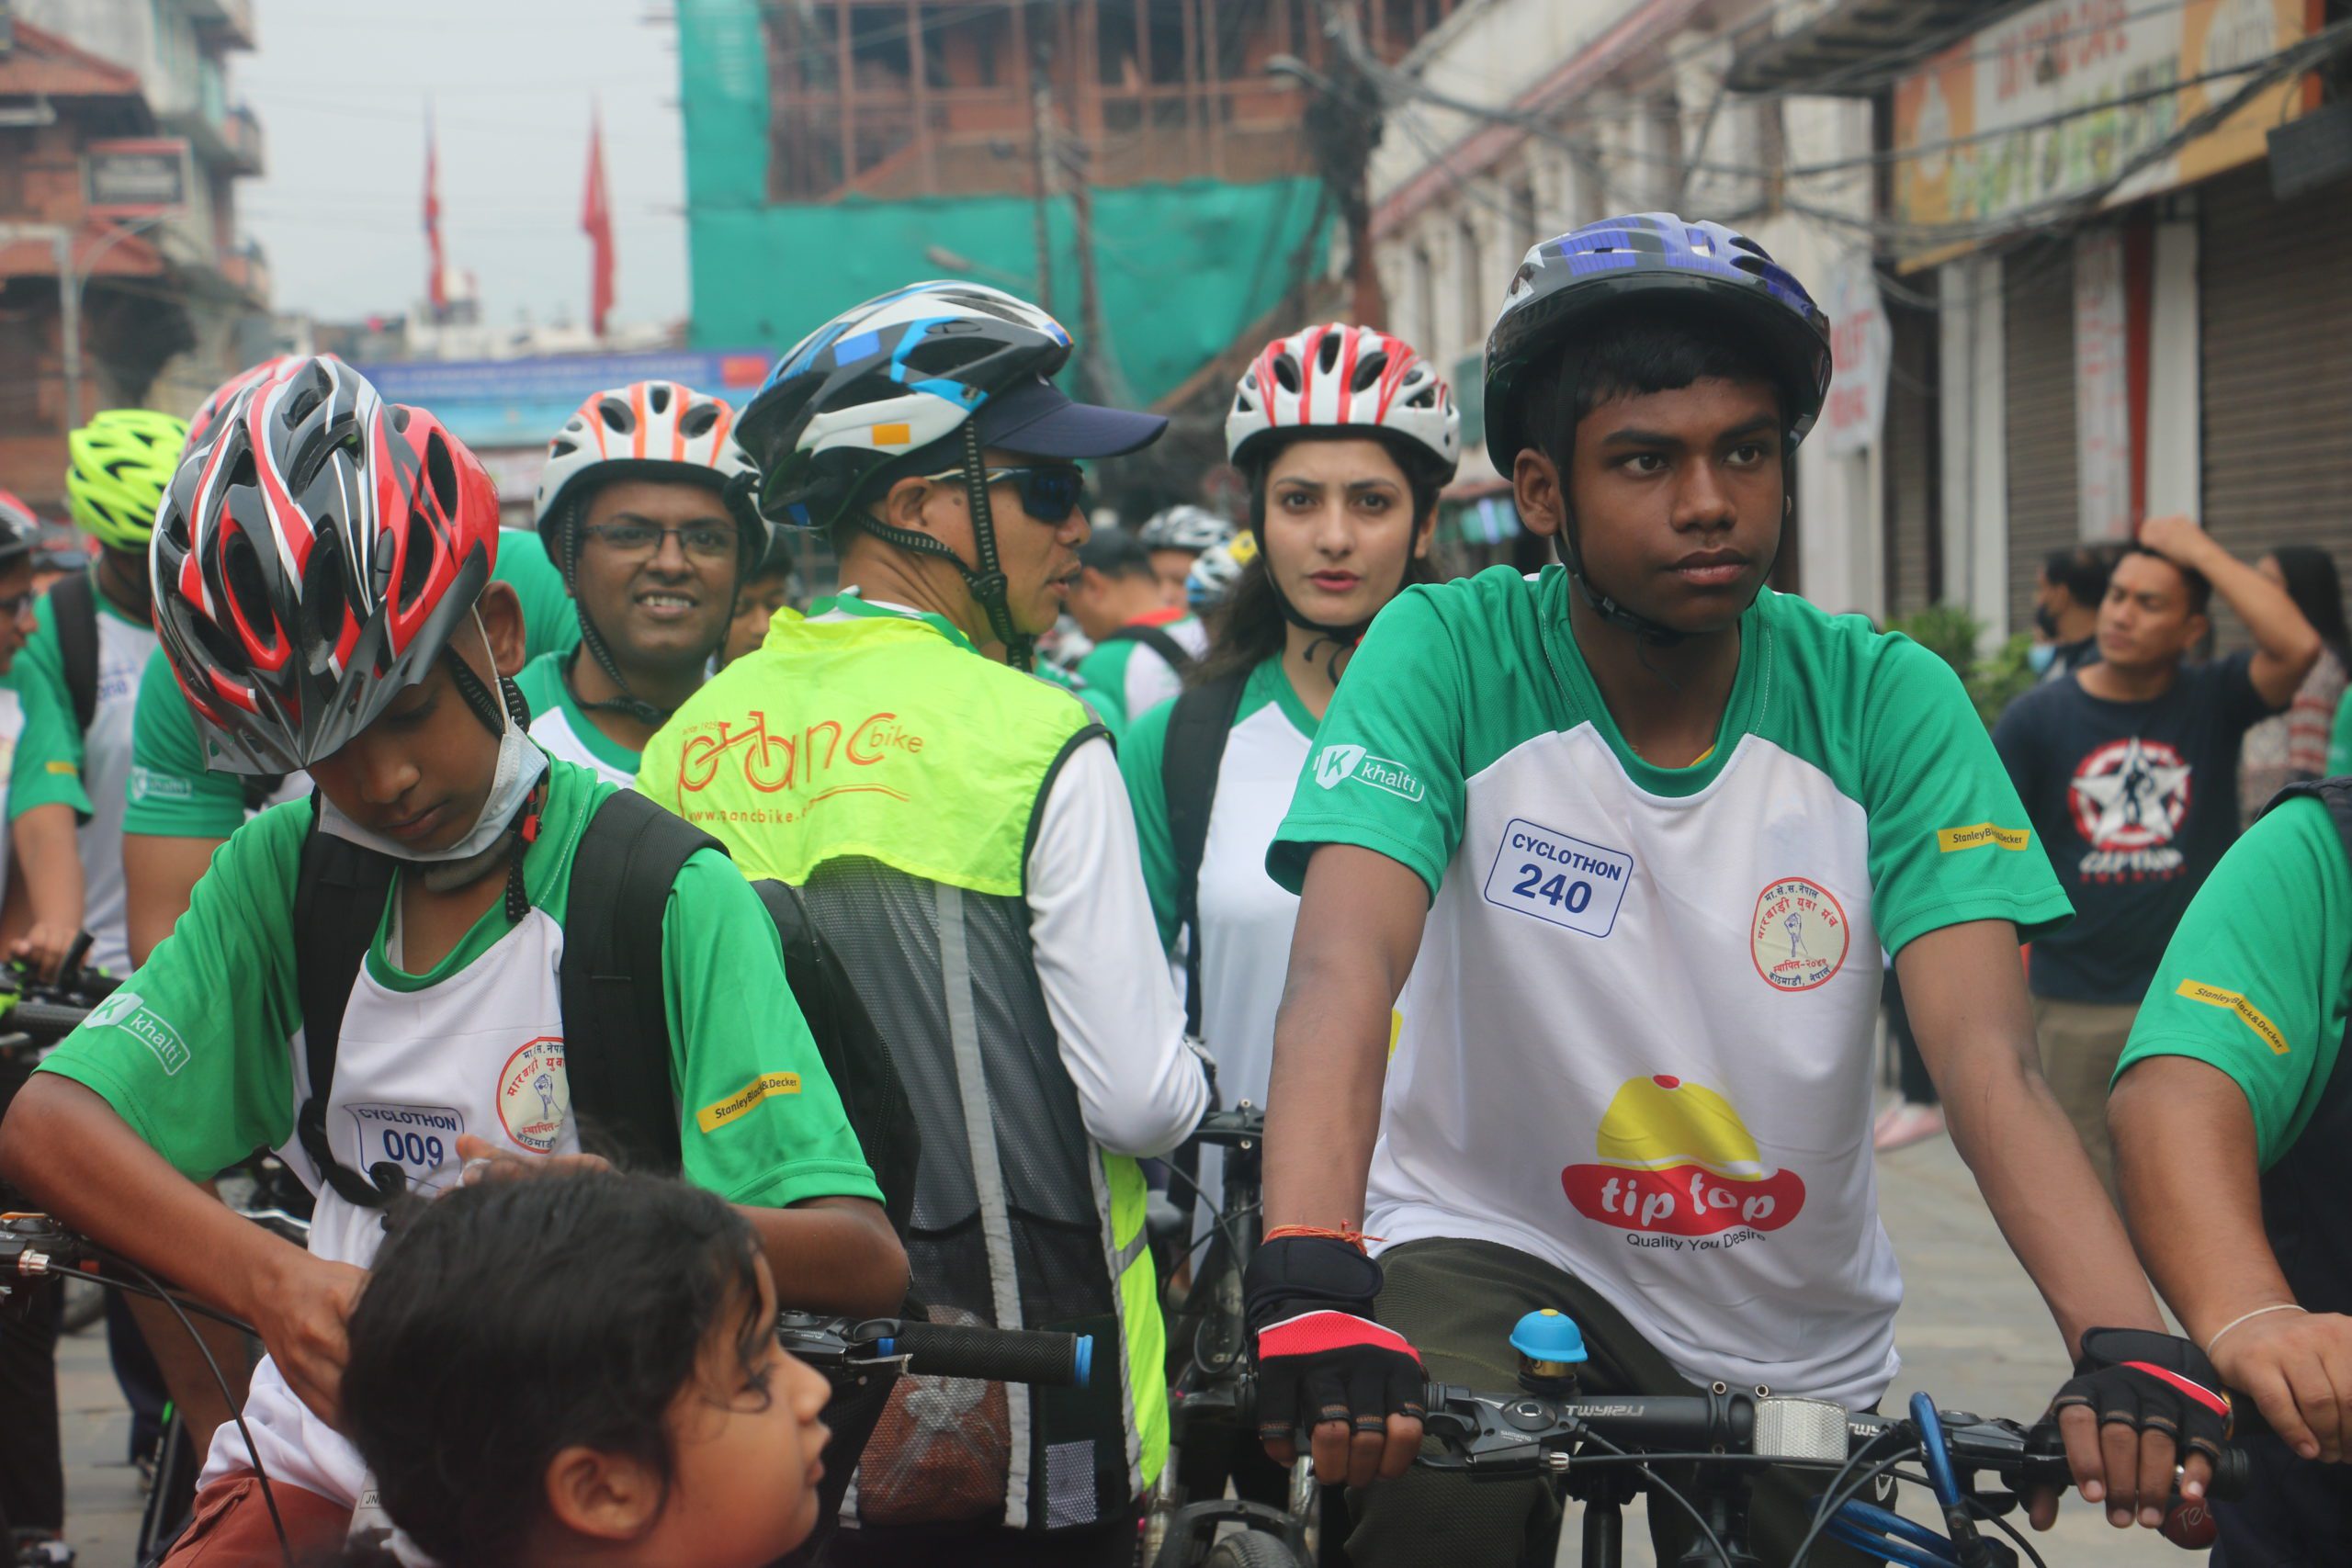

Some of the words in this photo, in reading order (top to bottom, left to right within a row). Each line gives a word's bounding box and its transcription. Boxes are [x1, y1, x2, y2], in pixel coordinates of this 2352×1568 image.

[868, 725, 924, 754] bike
[1361, 761, 1418, 794] khalti
[1511, 833, 1623, 882] CYCLOTHON
[1511, 863, 1592, 914] 240
[1797, 897, 1817, 911] युवा
[130, 1013, 182, 1065] khalti
[2194, 987, 2283, 1049] StanleyBlack&Decker
[358, 1108, 458, 1132] CYCLOTHON
[382, 1128, 444, 1170] 009
[1601, 1178, 1675, 1226] tip
[1690, 1172, 1776, 1223] top
[1626, 1233, 1683, 1251] Quality
[1688, 1238, 1720, 1251] You
